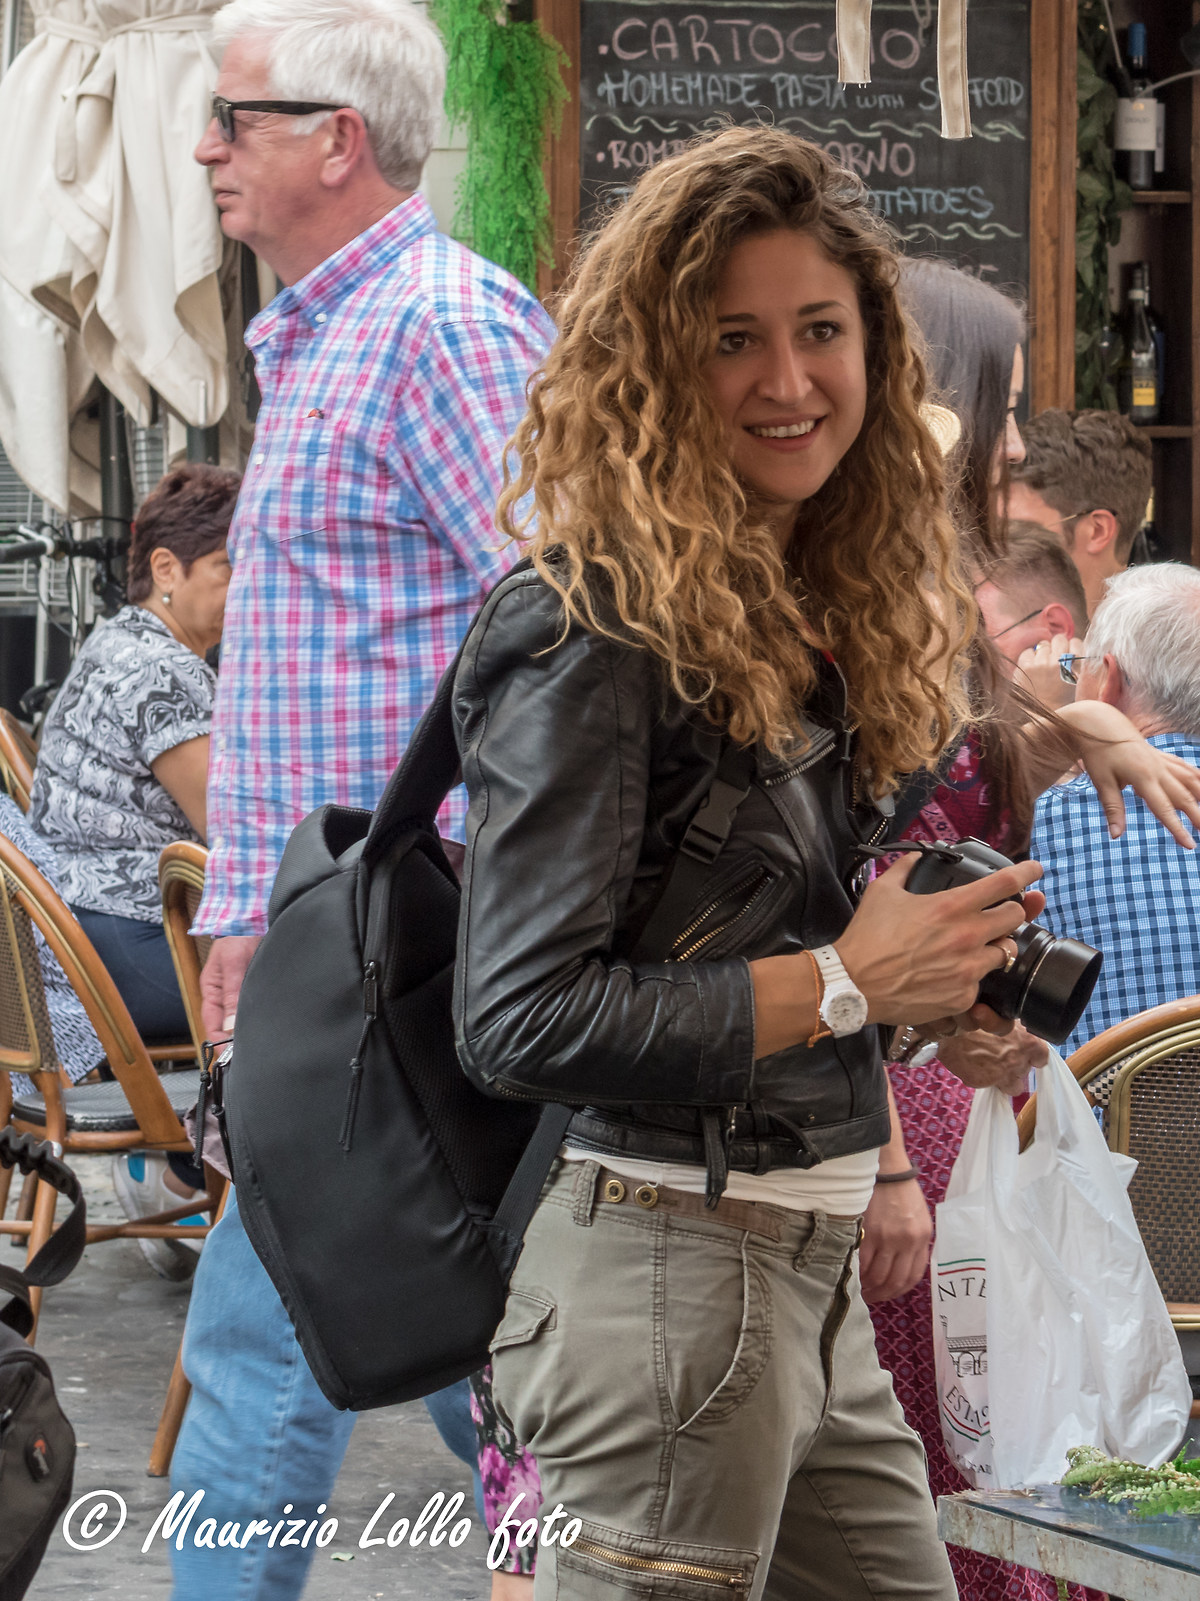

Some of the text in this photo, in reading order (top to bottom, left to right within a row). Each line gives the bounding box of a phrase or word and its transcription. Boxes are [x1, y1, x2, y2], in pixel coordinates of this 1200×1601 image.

[598, 68, 761, 108] HOMEMADE
[770, 72, 847, 109] PASTA
[918, 76, 1024, 110] SFOOD
[812, 138, 916, 178] ORNO
[845, 186, 994, 219] OTATOES
